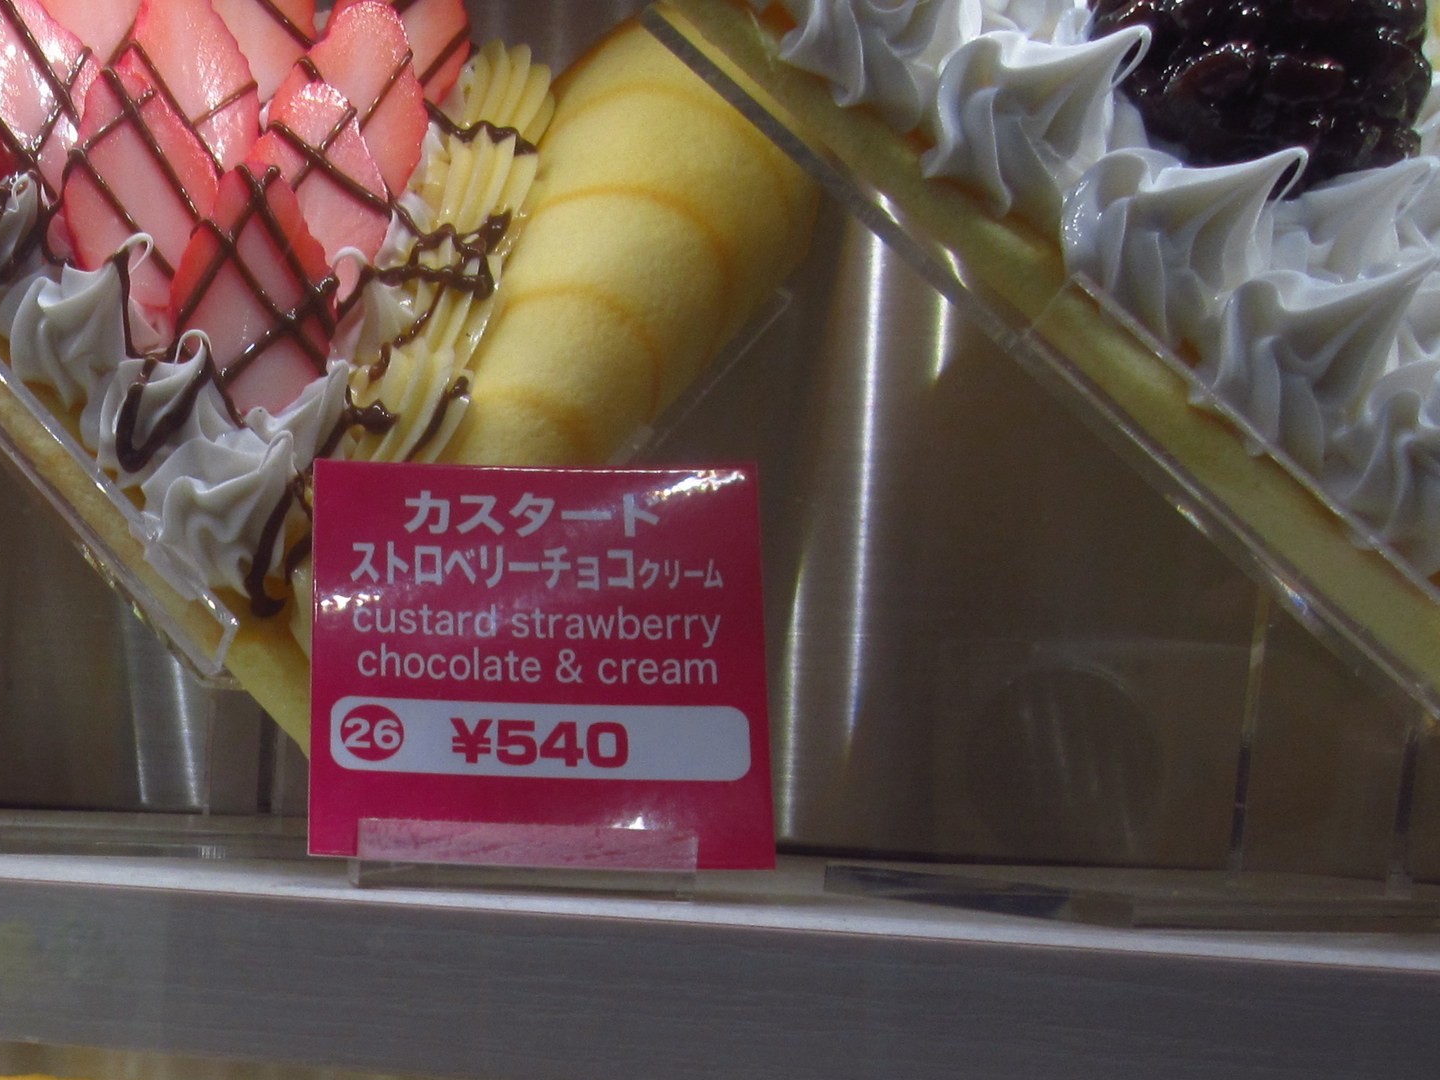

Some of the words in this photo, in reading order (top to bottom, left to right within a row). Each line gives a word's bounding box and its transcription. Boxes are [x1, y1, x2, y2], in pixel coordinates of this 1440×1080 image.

[404, 490, 660, 537] カスタード
[350, 541, 723, 591] ストロベリーチョコクリーム
[352, 604, 497, 637] custard
[511, 605, 721, 647] strawberry
[357, 644, 542, 683] chocolate
[556, 648, 583, 684] &
[597, 656, 717, 685] cream
[344, 718, 401, 749] 26
[450, 718, 629, 768] ¥540
